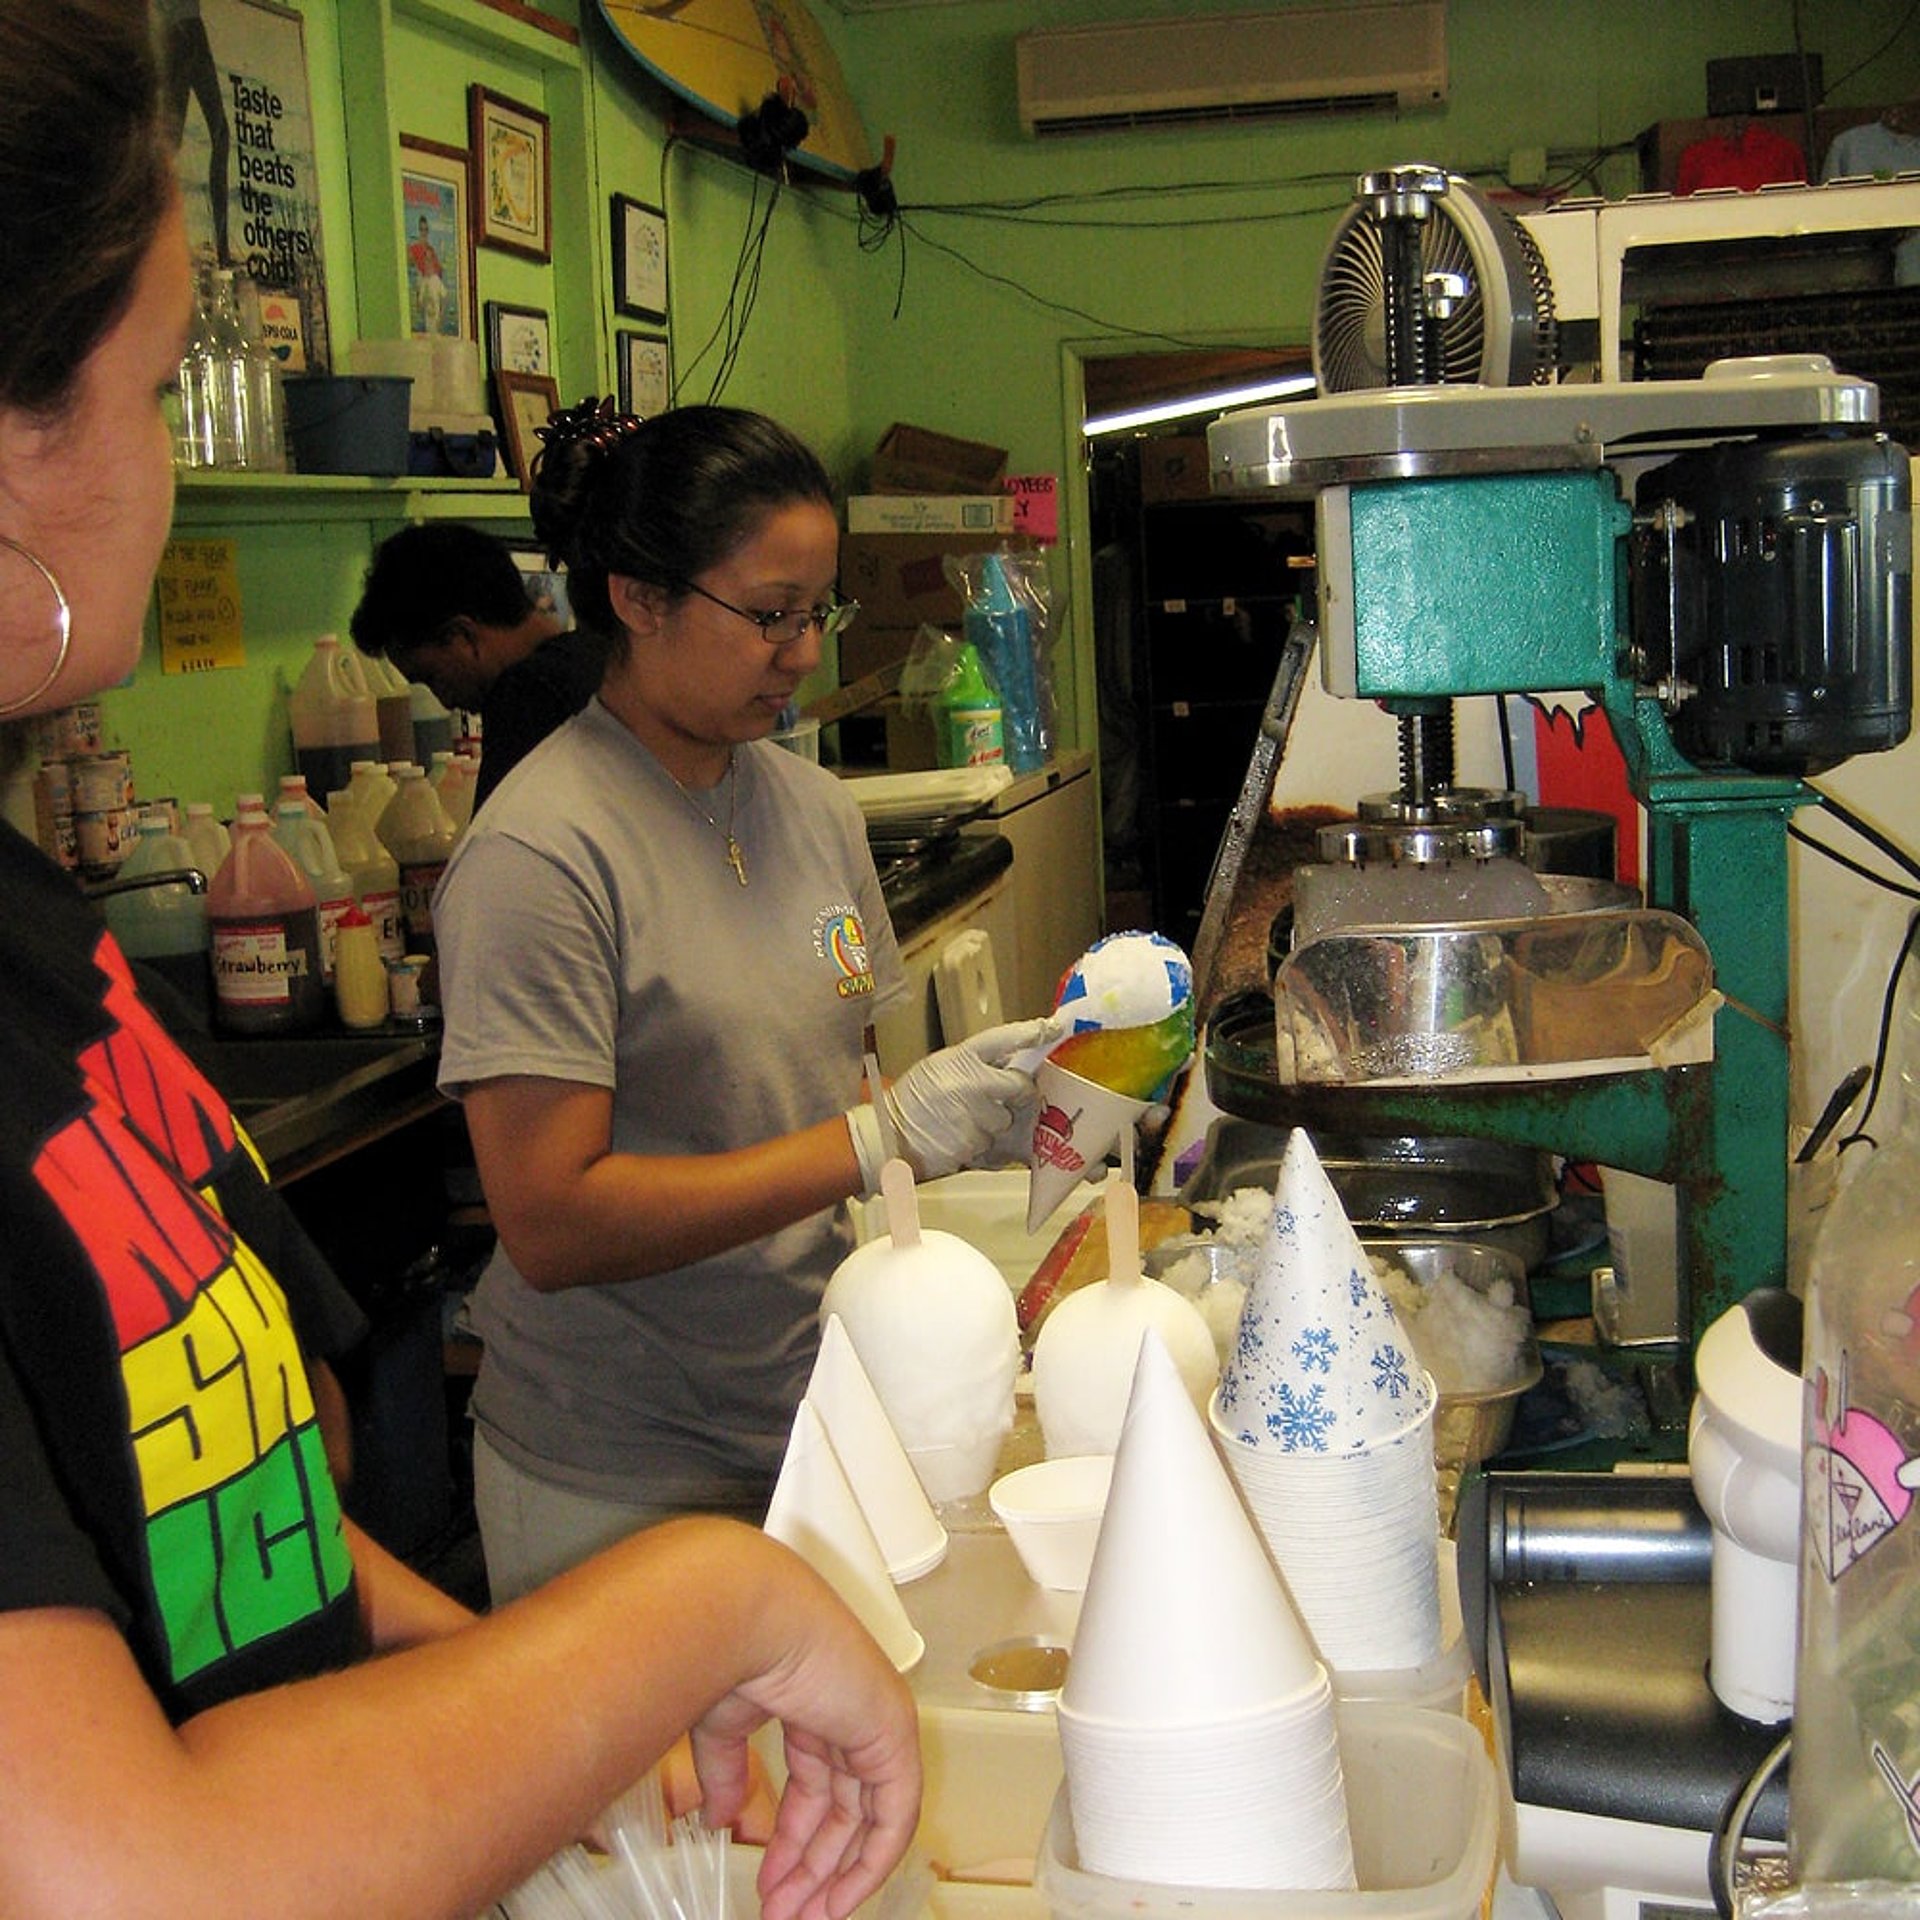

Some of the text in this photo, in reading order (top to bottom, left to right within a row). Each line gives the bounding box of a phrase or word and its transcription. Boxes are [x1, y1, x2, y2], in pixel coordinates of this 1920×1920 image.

[228, 73, 282, 119] Taste
[235, 110, 275, 151] that
[239, 144, 295, 189] beats
[240, 180, 272, 216] the
[243, 216, 308, 254] others
[217, 953, 300, 976] Strawberry
